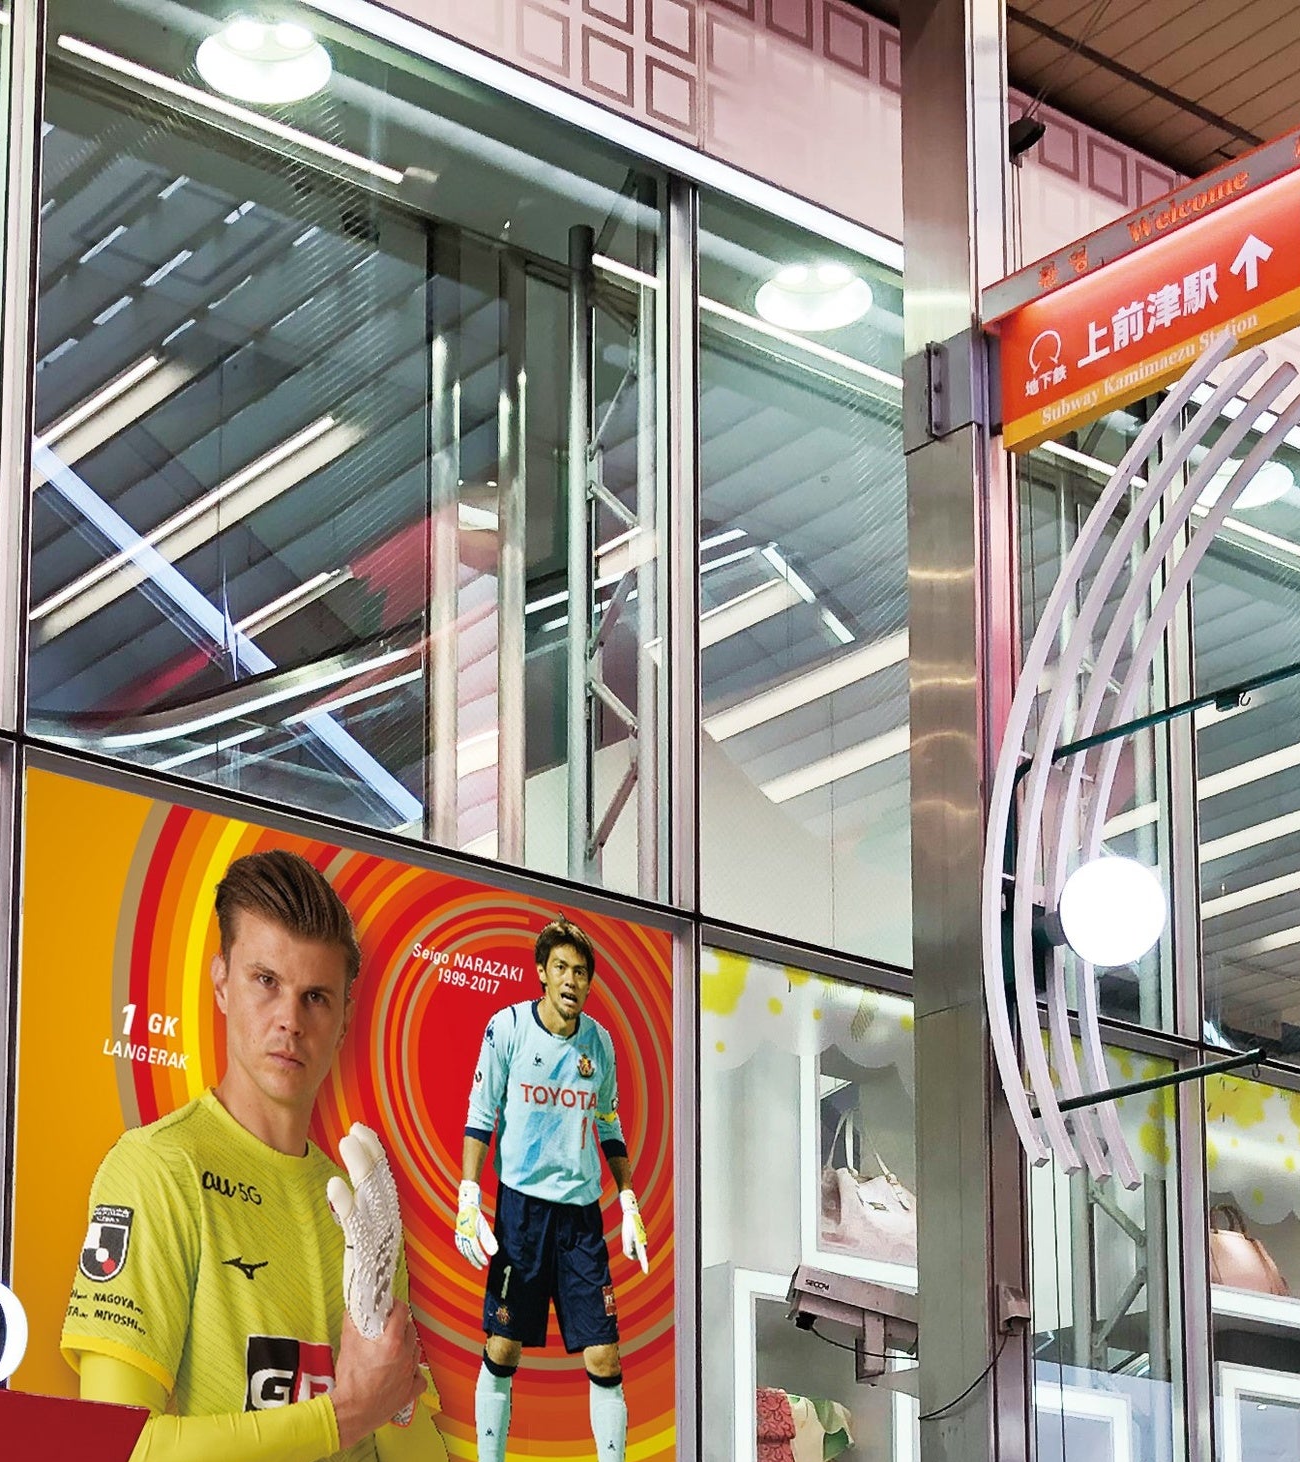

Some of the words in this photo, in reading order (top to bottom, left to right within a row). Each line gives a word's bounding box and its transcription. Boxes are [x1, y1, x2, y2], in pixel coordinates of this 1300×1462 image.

[1127, 172, 1250, 242] Welcome
[1077, 263, 1218, 368] 上前津駅
[1025, 365, 1067, 396] 地下鉄
[1040, 383, 1100, 425] Subway
[1103, 342, 1196, 396] Kamimaezu
[412, 942, 450, 965] Seigo
[453, 952, 524, 983] NARAZAKI
[436, 967, 500, 995] 1999-2017
[120, 1003, 137, 1035] 1
[148, 1013, 180, 1037] GK
[102, 1039, 189, 1071] LANGERAK
[520, 1083, 598, 1111] TOYOTA
[202, 1171, 236, 1197] au
